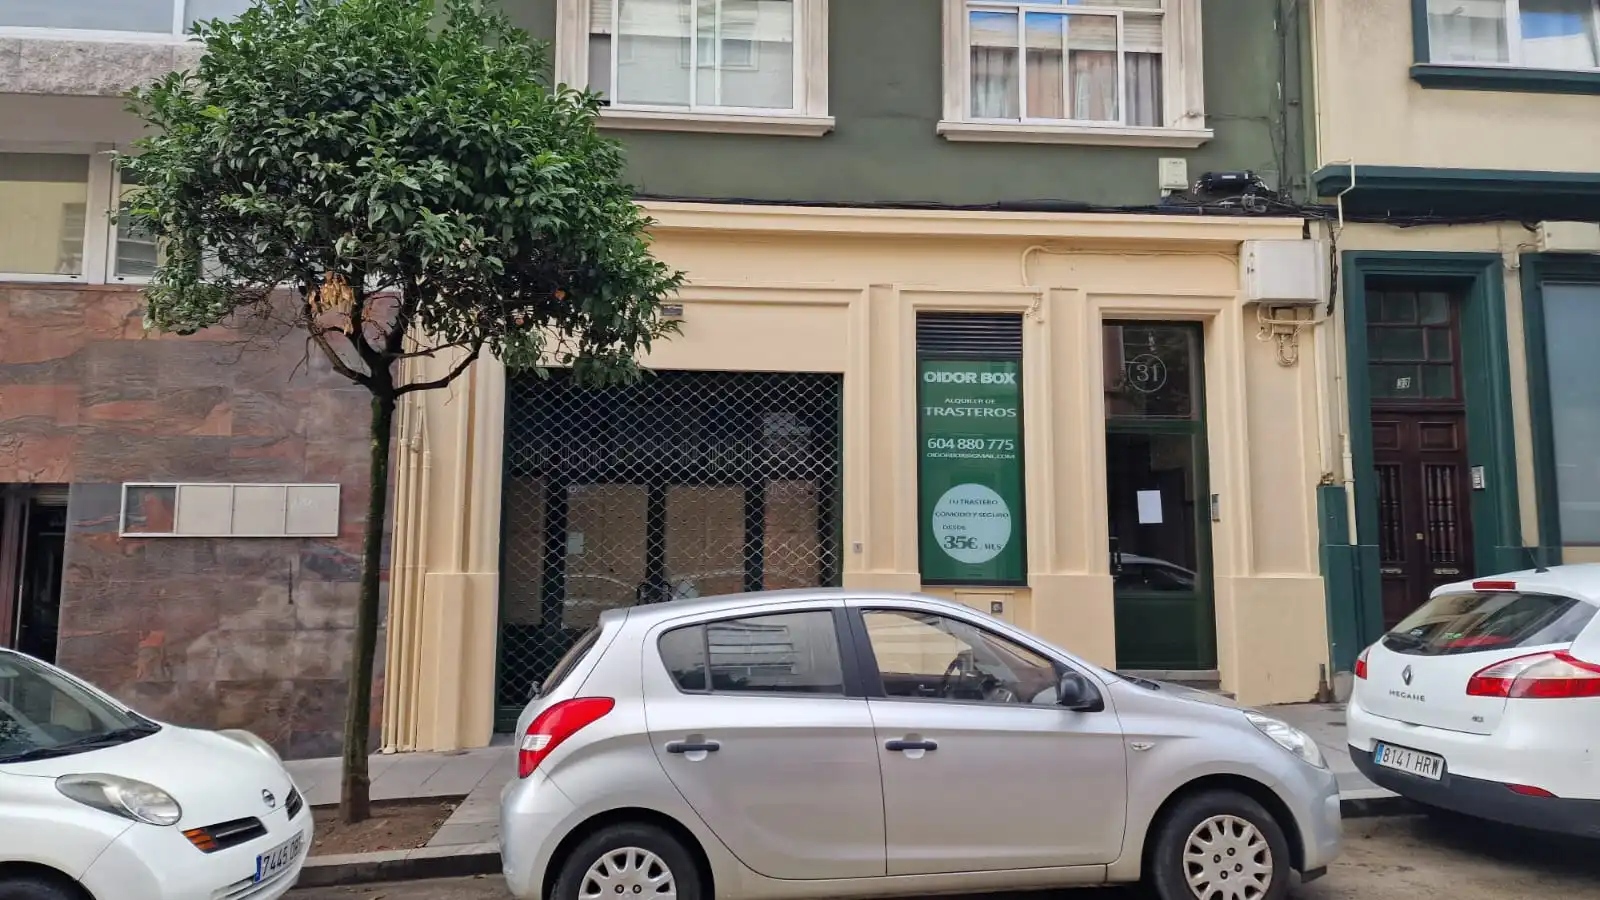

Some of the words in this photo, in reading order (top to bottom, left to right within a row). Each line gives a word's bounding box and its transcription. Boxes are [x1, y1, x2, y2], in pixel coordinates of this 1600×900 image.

[924, 371, 977, 384] OIDOR
[980, 372, 1016, 384] BOX
[1136, 364, 1158, 382] 31
[924, 407, 1017, 417] TRASTEROS
[927, 438, 955, 449] 604
[957, 438, 985, 450] 880
[987, 439, 1014, 451] 775
[943, 535, 978, 550] 35€
[1389, 689, 1426, 701] MEGANE
[1382, 747, 1411, 769] 8141
[1414, 755, 1440, 776] HRW
[262, 846, 288, 877] 7445
